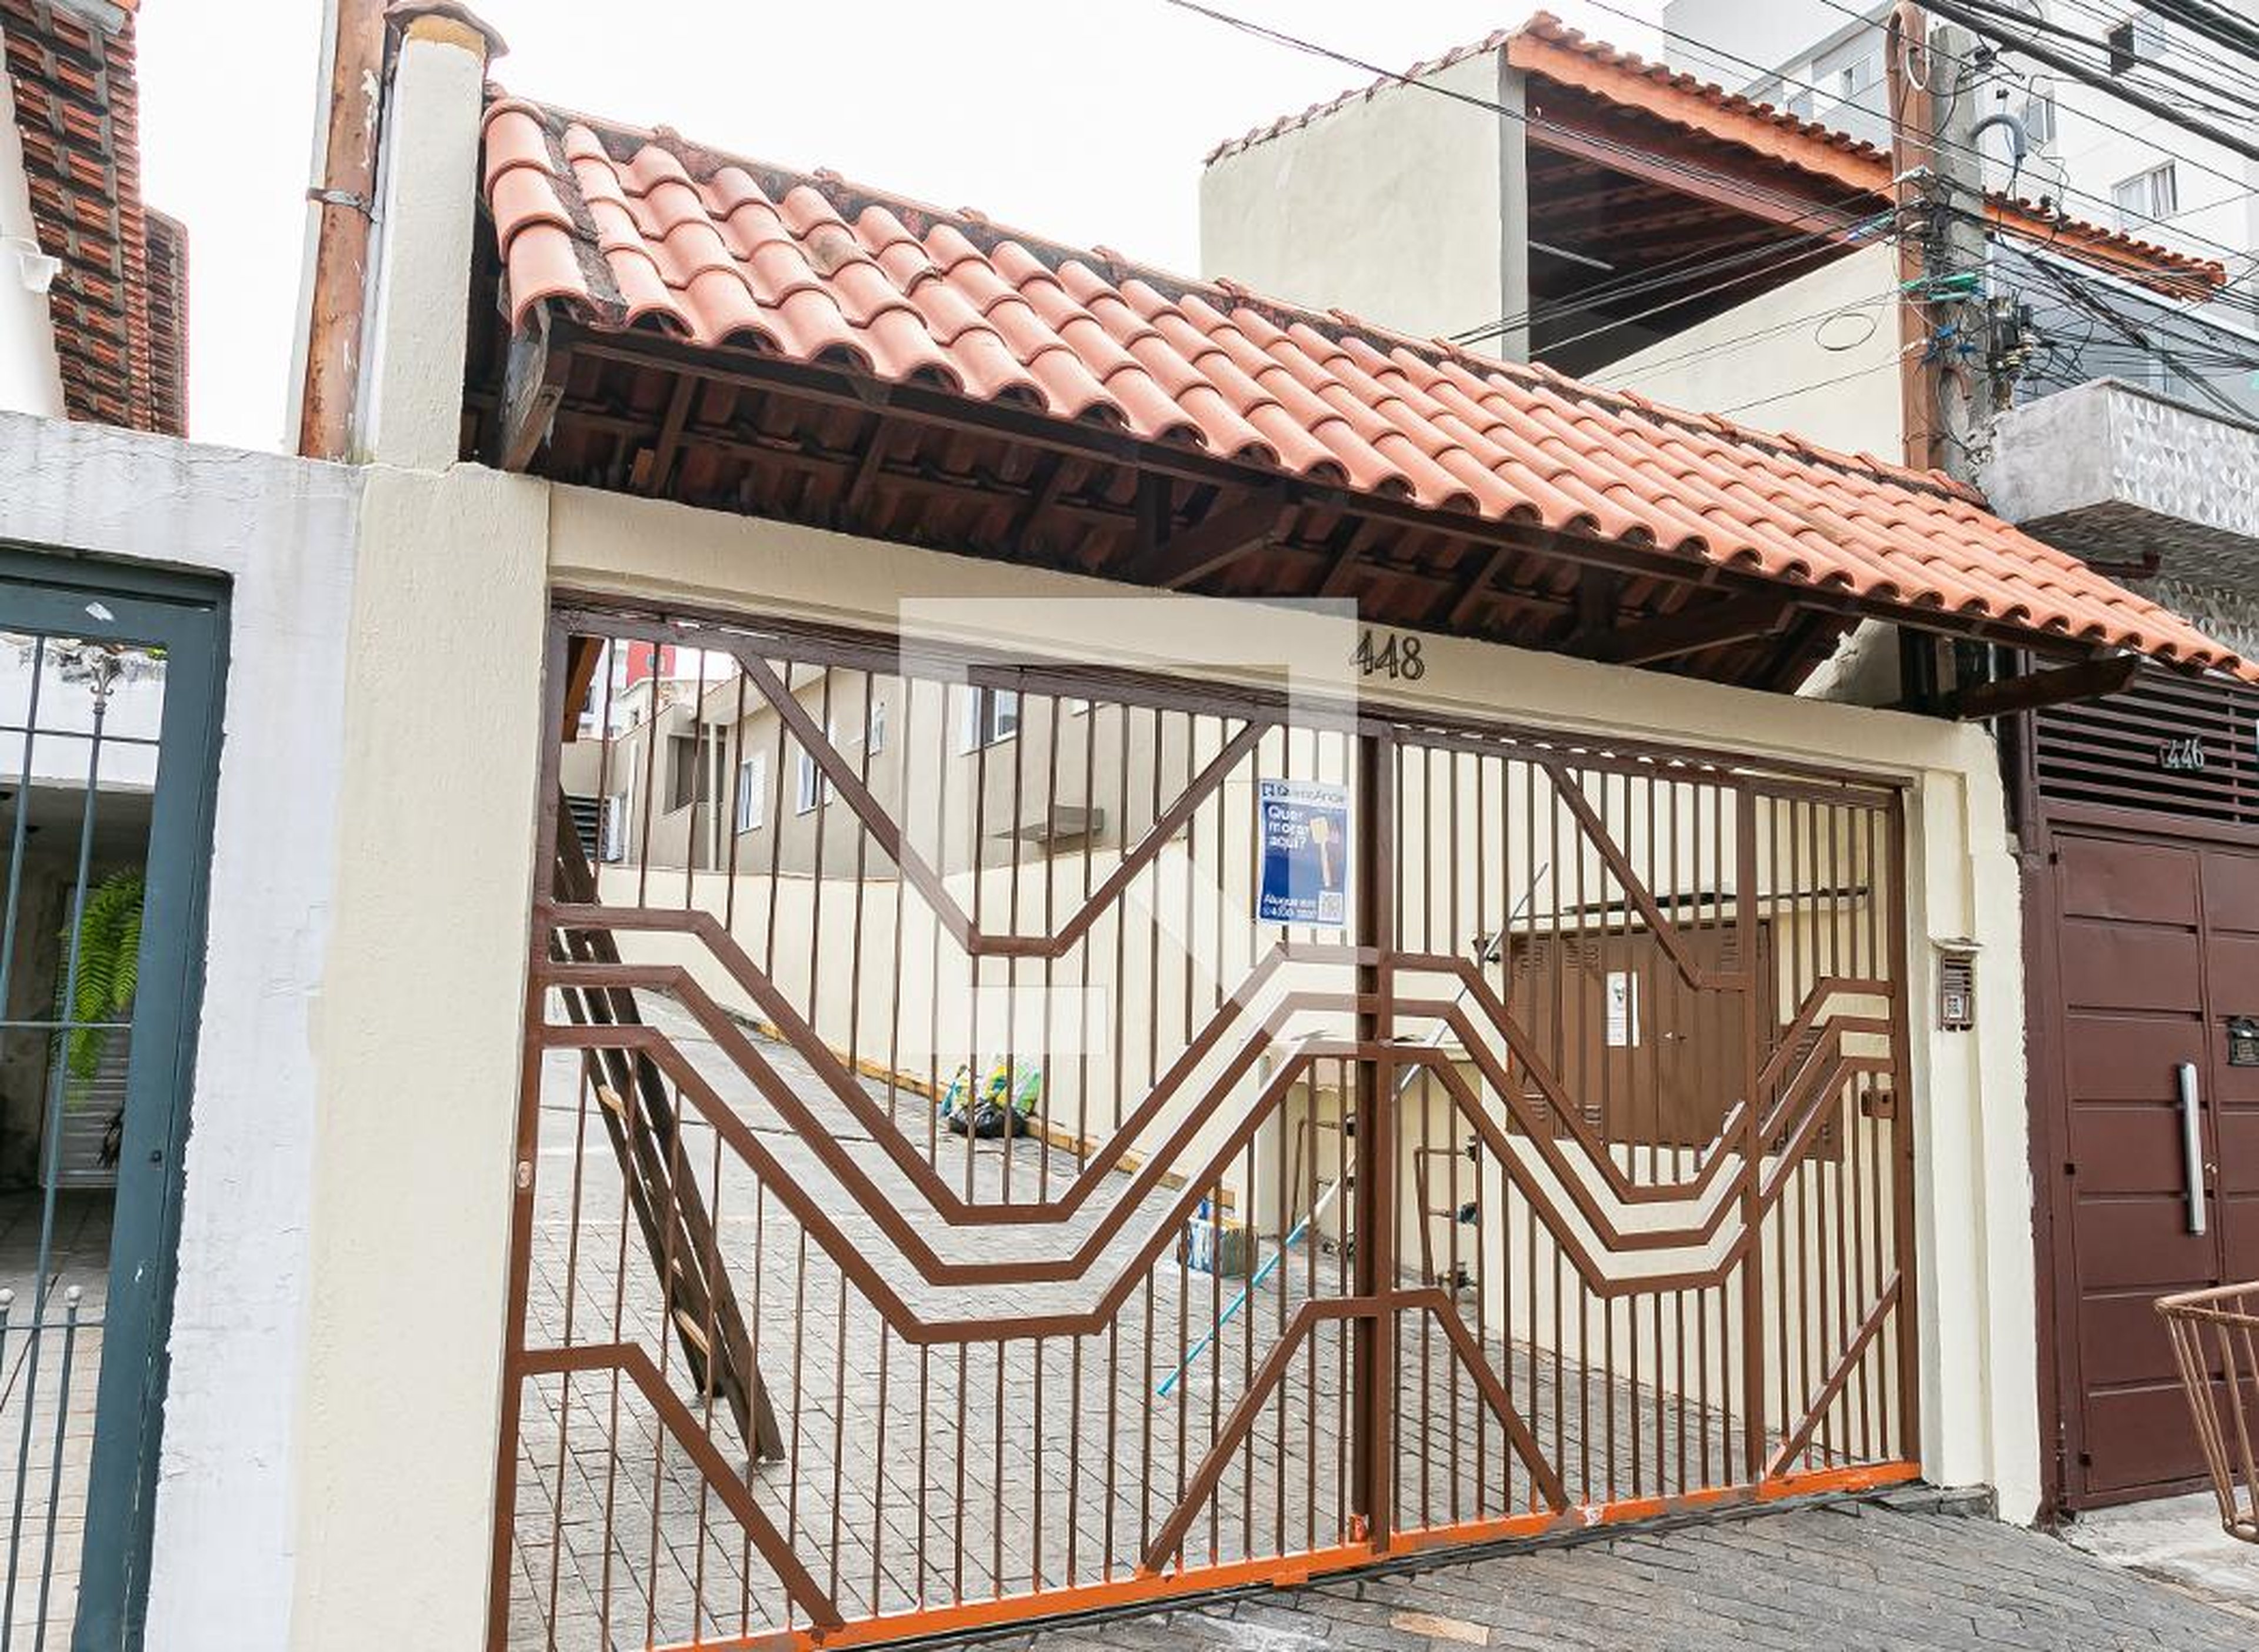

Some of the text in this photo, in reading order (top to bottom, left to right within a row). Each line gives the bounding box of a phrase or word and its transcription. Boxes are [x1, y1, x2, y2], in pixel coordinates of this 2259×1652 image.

[1349, 630, 1425, 680] 448
[2168, 739, 2204, 769] 446
[1268, 805, 1304, 820] Quer
[1269, 836, 1307, 850] aqui?
